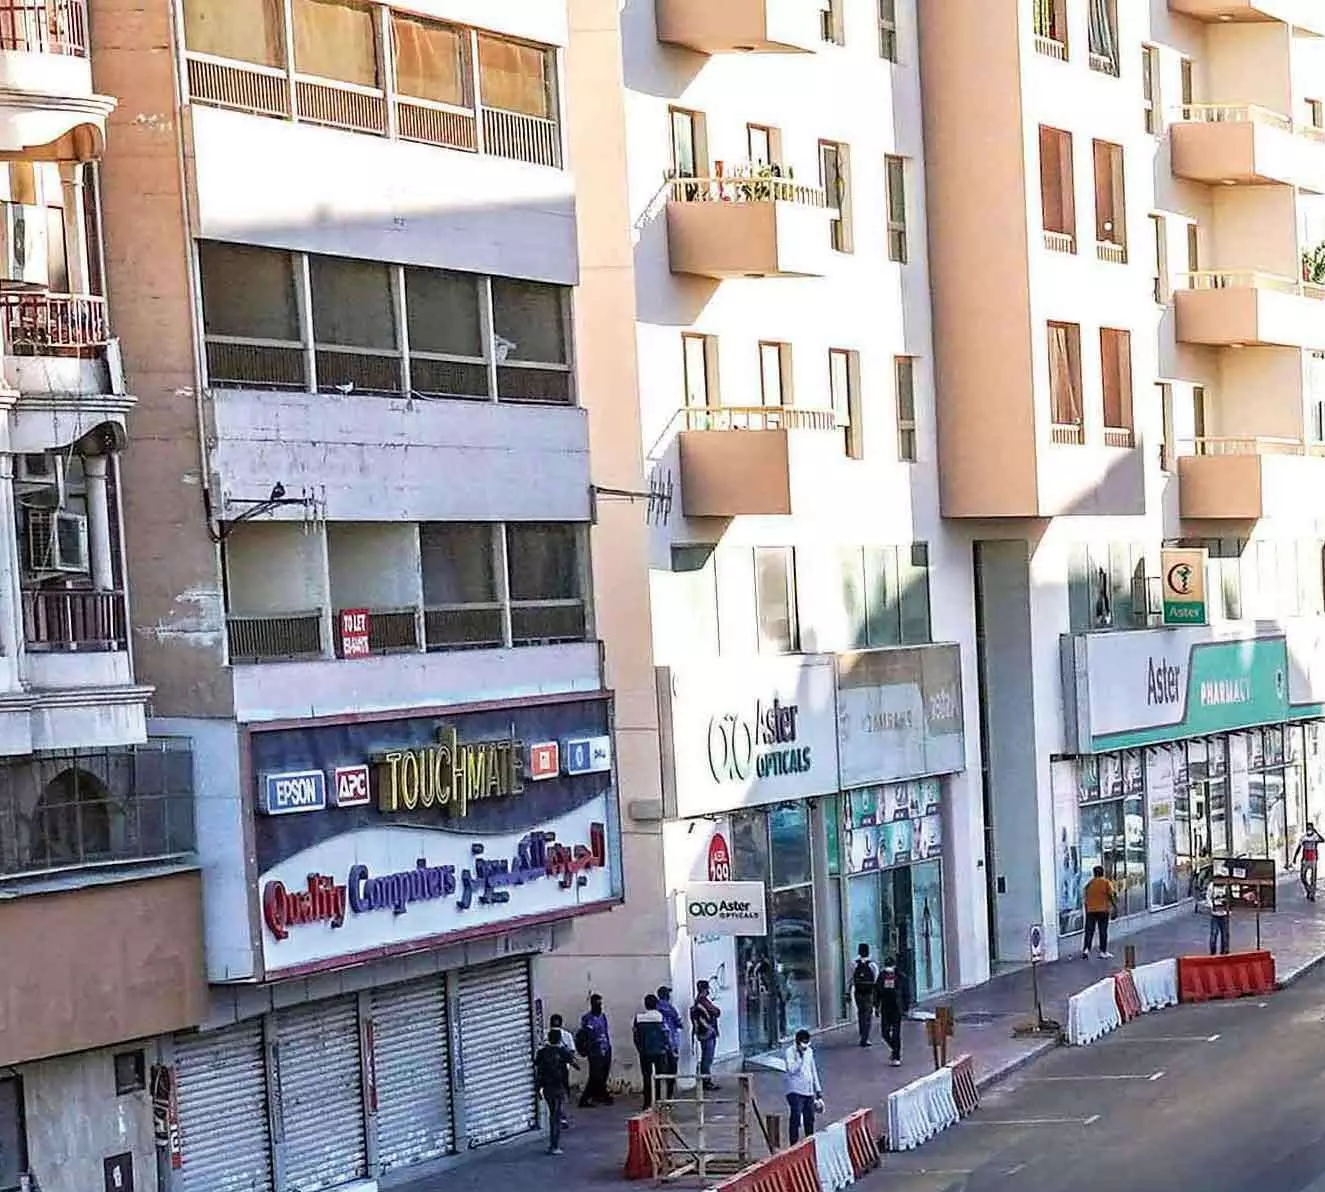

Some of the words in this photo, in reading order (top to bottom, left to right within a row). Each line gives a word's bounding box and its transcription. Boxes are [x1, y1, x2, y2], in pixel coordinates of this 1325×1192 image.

[343, 614, 353, 633] TO
[353, 614, 367, 632] LET
[1168, 606, 1200, 617] Aster
[1147, 656, 1180, 706] Aster
[756, 698, 798, 746] Aster
[756, 747, 811, 778] OPTICALS
[275, 777, 316, 806] EPSON
[338, 771, 367, 798] APC
[264, 873, 347, 940] Quality
[349, 858, 456, 915] Computers
[719, 900, 751, 912] Aster
[719, 911, 760, 919] OPTICALS
